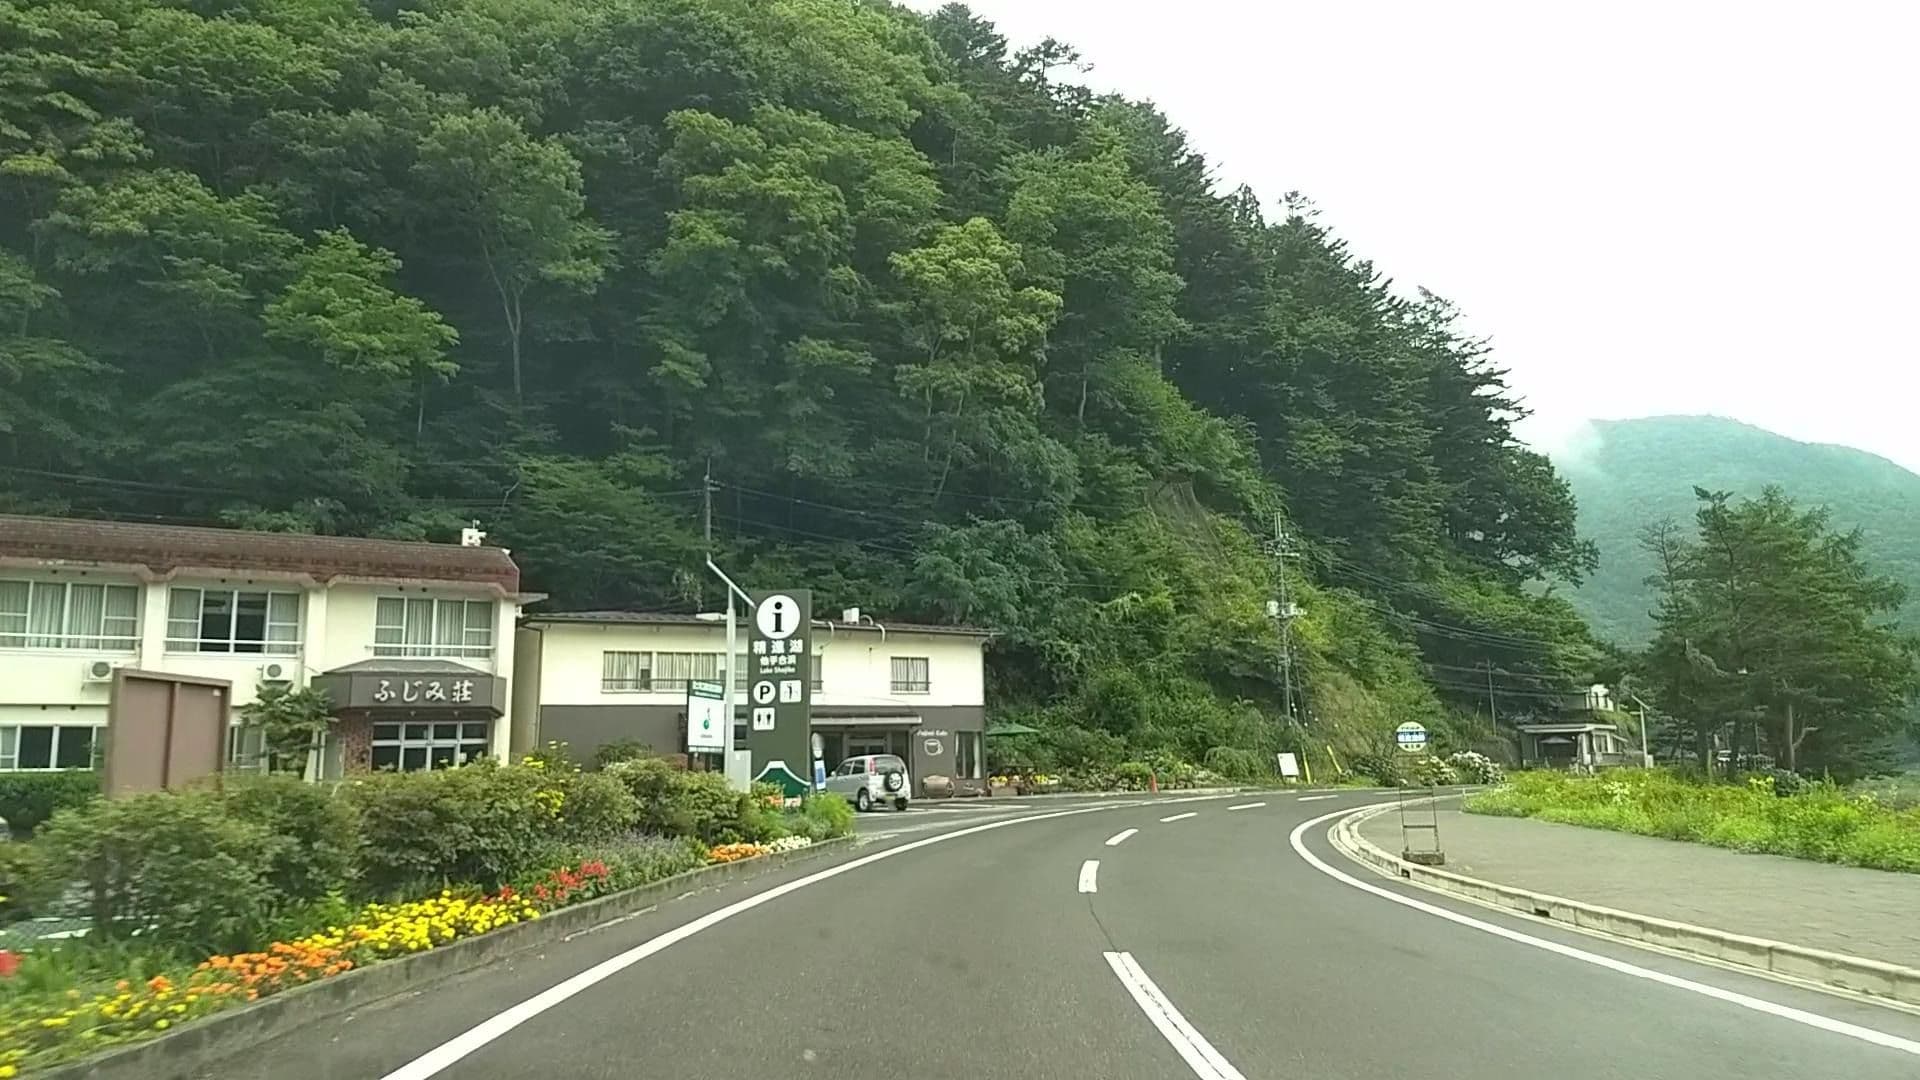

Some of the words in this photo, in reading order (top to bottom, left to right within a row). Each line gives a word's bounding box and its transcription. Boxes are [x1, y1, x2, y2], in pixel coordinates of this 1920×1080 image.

[772, 601, 784, 633] i
[759, 667, 773, 675] Lake
[373, 679, 474, 703] ふじみ荘
[759, 685, 770, 700] P
